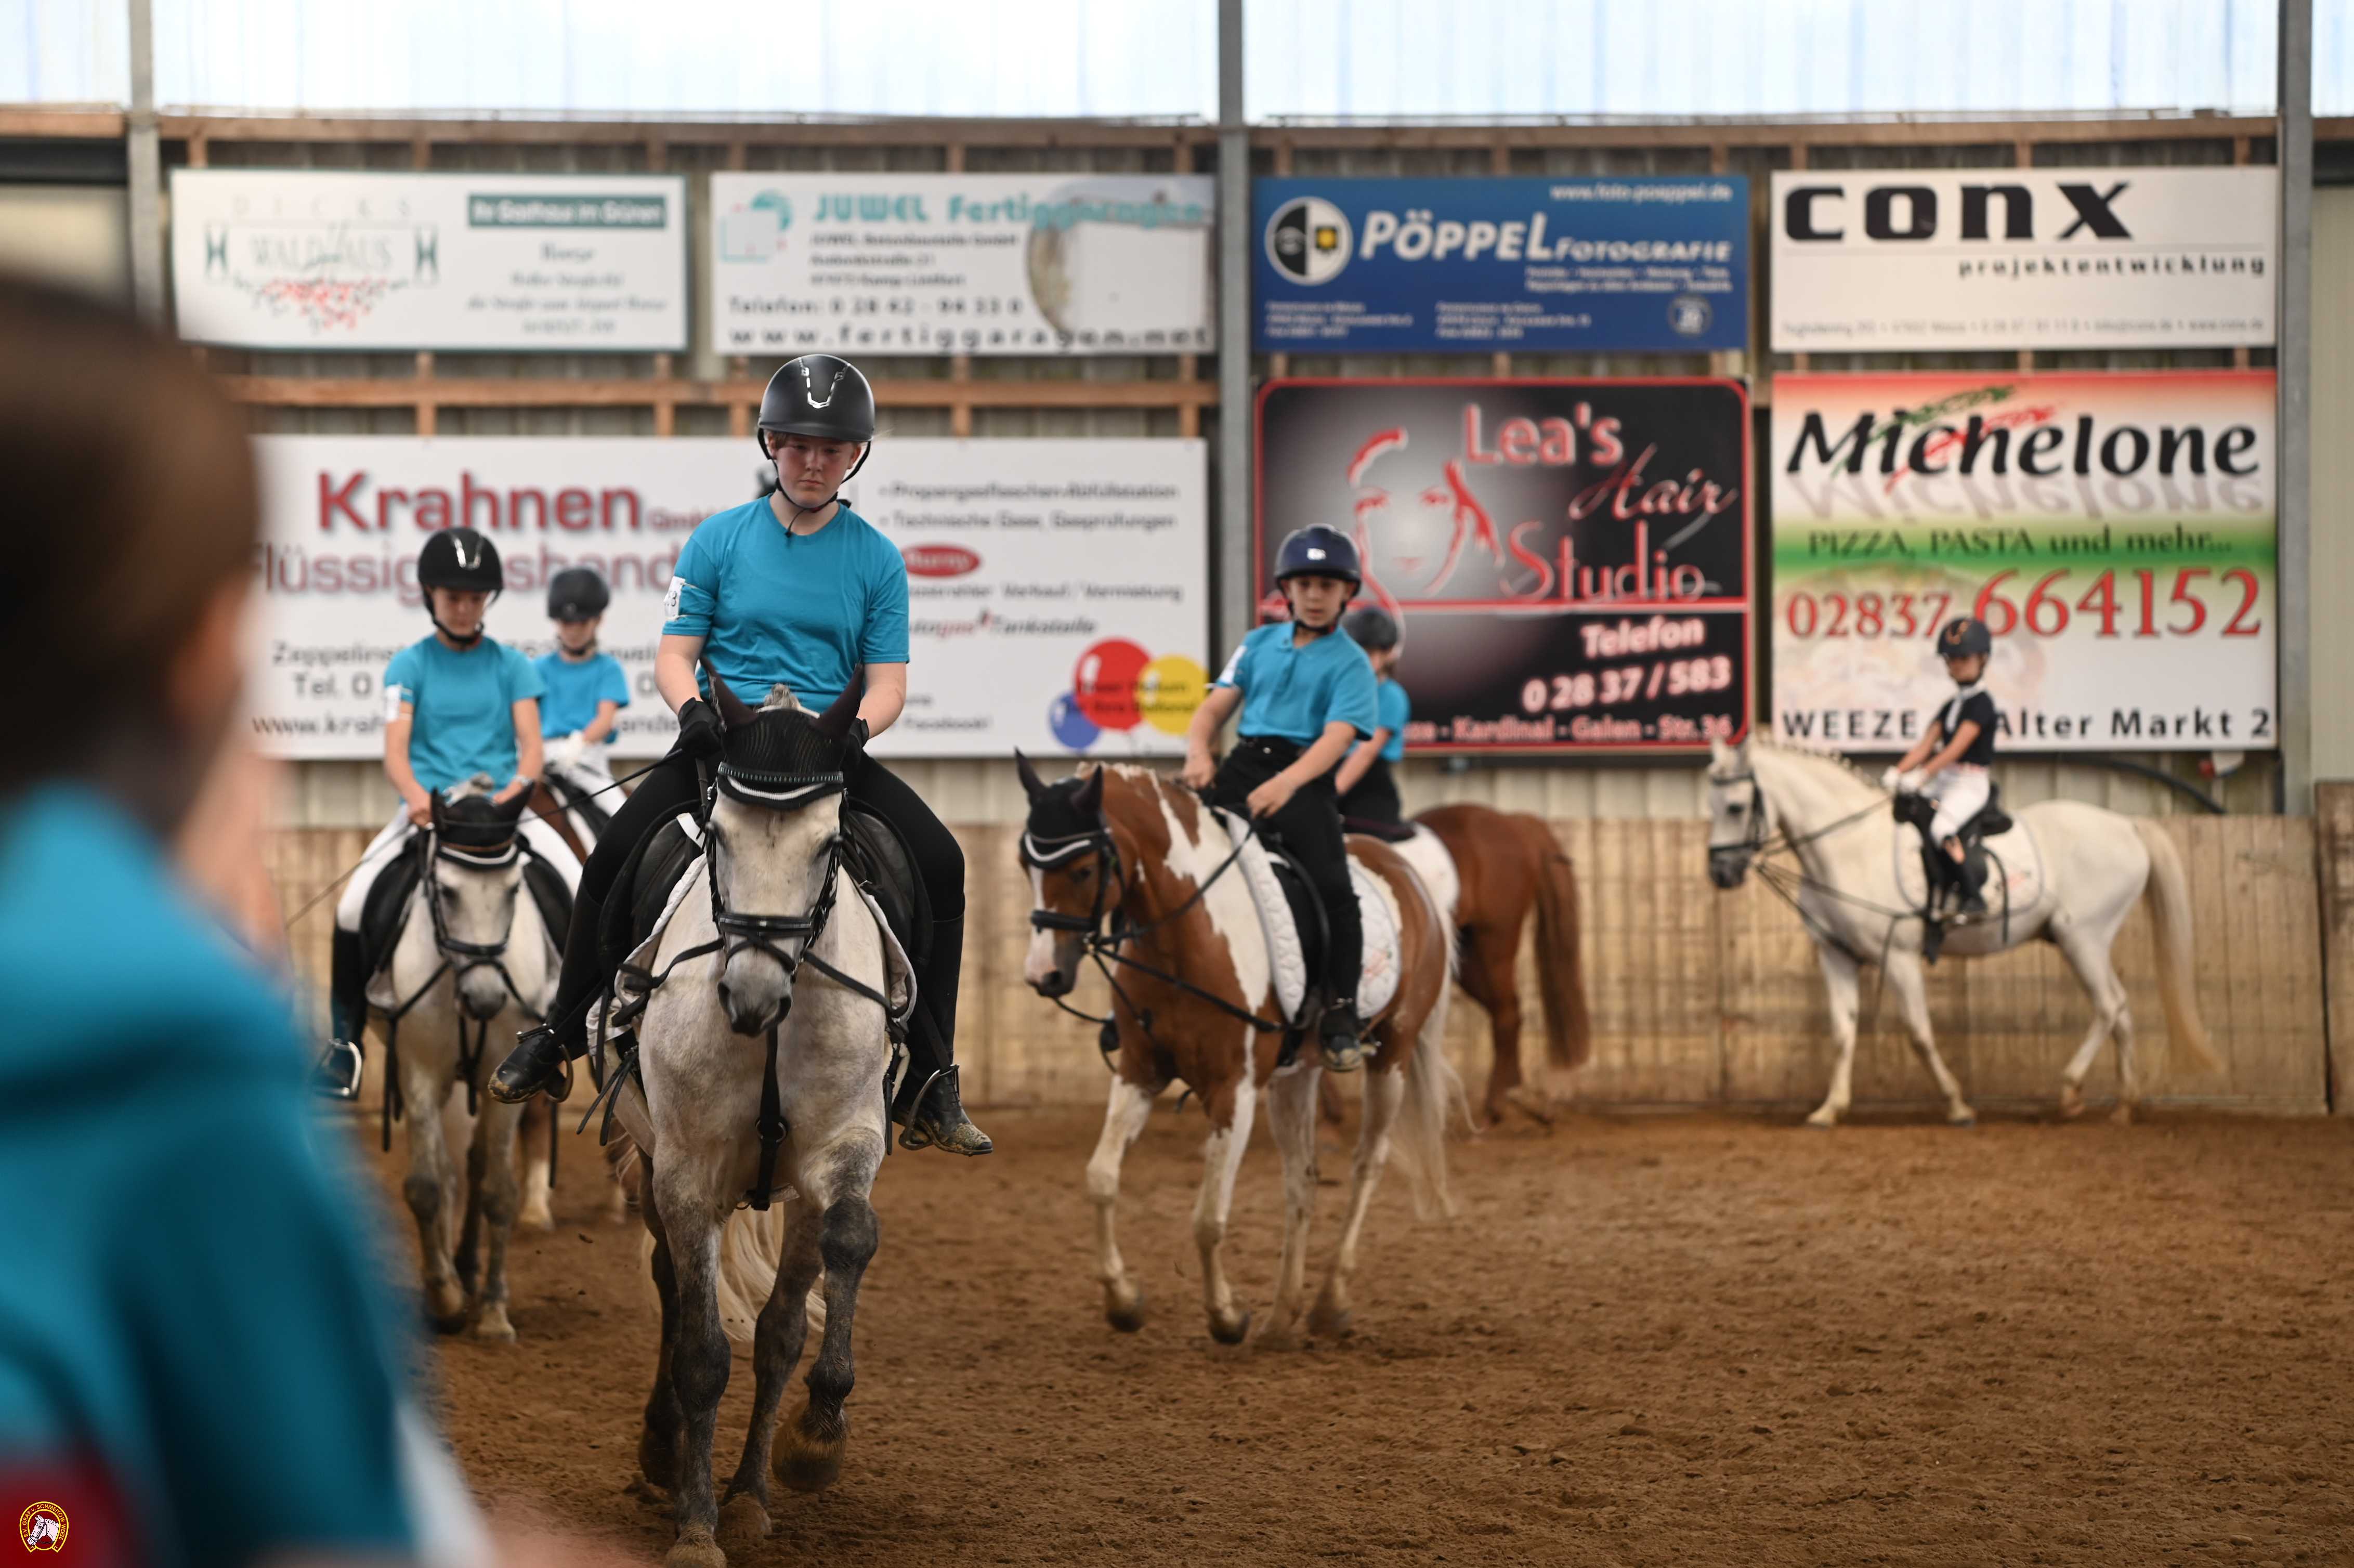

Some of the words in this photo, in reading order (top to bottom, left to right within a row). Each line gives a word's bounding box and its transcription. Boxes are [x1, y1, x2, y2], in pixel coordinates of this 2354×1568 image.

[811, 192, 931, 224] JUWEL
[1549, 183, 1733, 204] www.foto-poeppel.de
[1783, 181, 2135, 242] conx
[1359, 209, 1552, 260] PÖPPEL
[1552, 238, 1733, 262] FOTOGRAFIE
[1957, 255, 2267, 281] projektentwicklung
[728, 296, 823, 316] Telefon:
[728, 323, 1210, 352] www.fertiggaragen.net
[1463, 401, 1625, 466] Lea's
[1784, 410, 2263, 477] Michelone
[317, 469, 644, 532] Krahnen
[1567, 442, 1741, 521] Hair
[1807, 528, 1918, 559] PIZZA,
[1929, 527, 2035, 557] PASTA
[2049, 524, 2112, 556] und
[1498, 520, 1708, 604] Studio
[1786, 592, 1952, 639] 02837
[1973, 567, 2264, 639] 664152
[1580, 613, 1706, 660] Telefon
[292, 671, 339, 699] Tel.
[350, 671, 372, 699] 0
[1667, 656, 1733, 695] 583
[1452, 715, 1555, 742] Kardinal
[1570, 715, 1643, 742] Galen
[1782, 709, 1919, 740] WEEZE
[1993, 708, 2093, 738] Alter
[2110, 707, 2233, 738] Markt
[2250, 707, 2272, 737] 2
